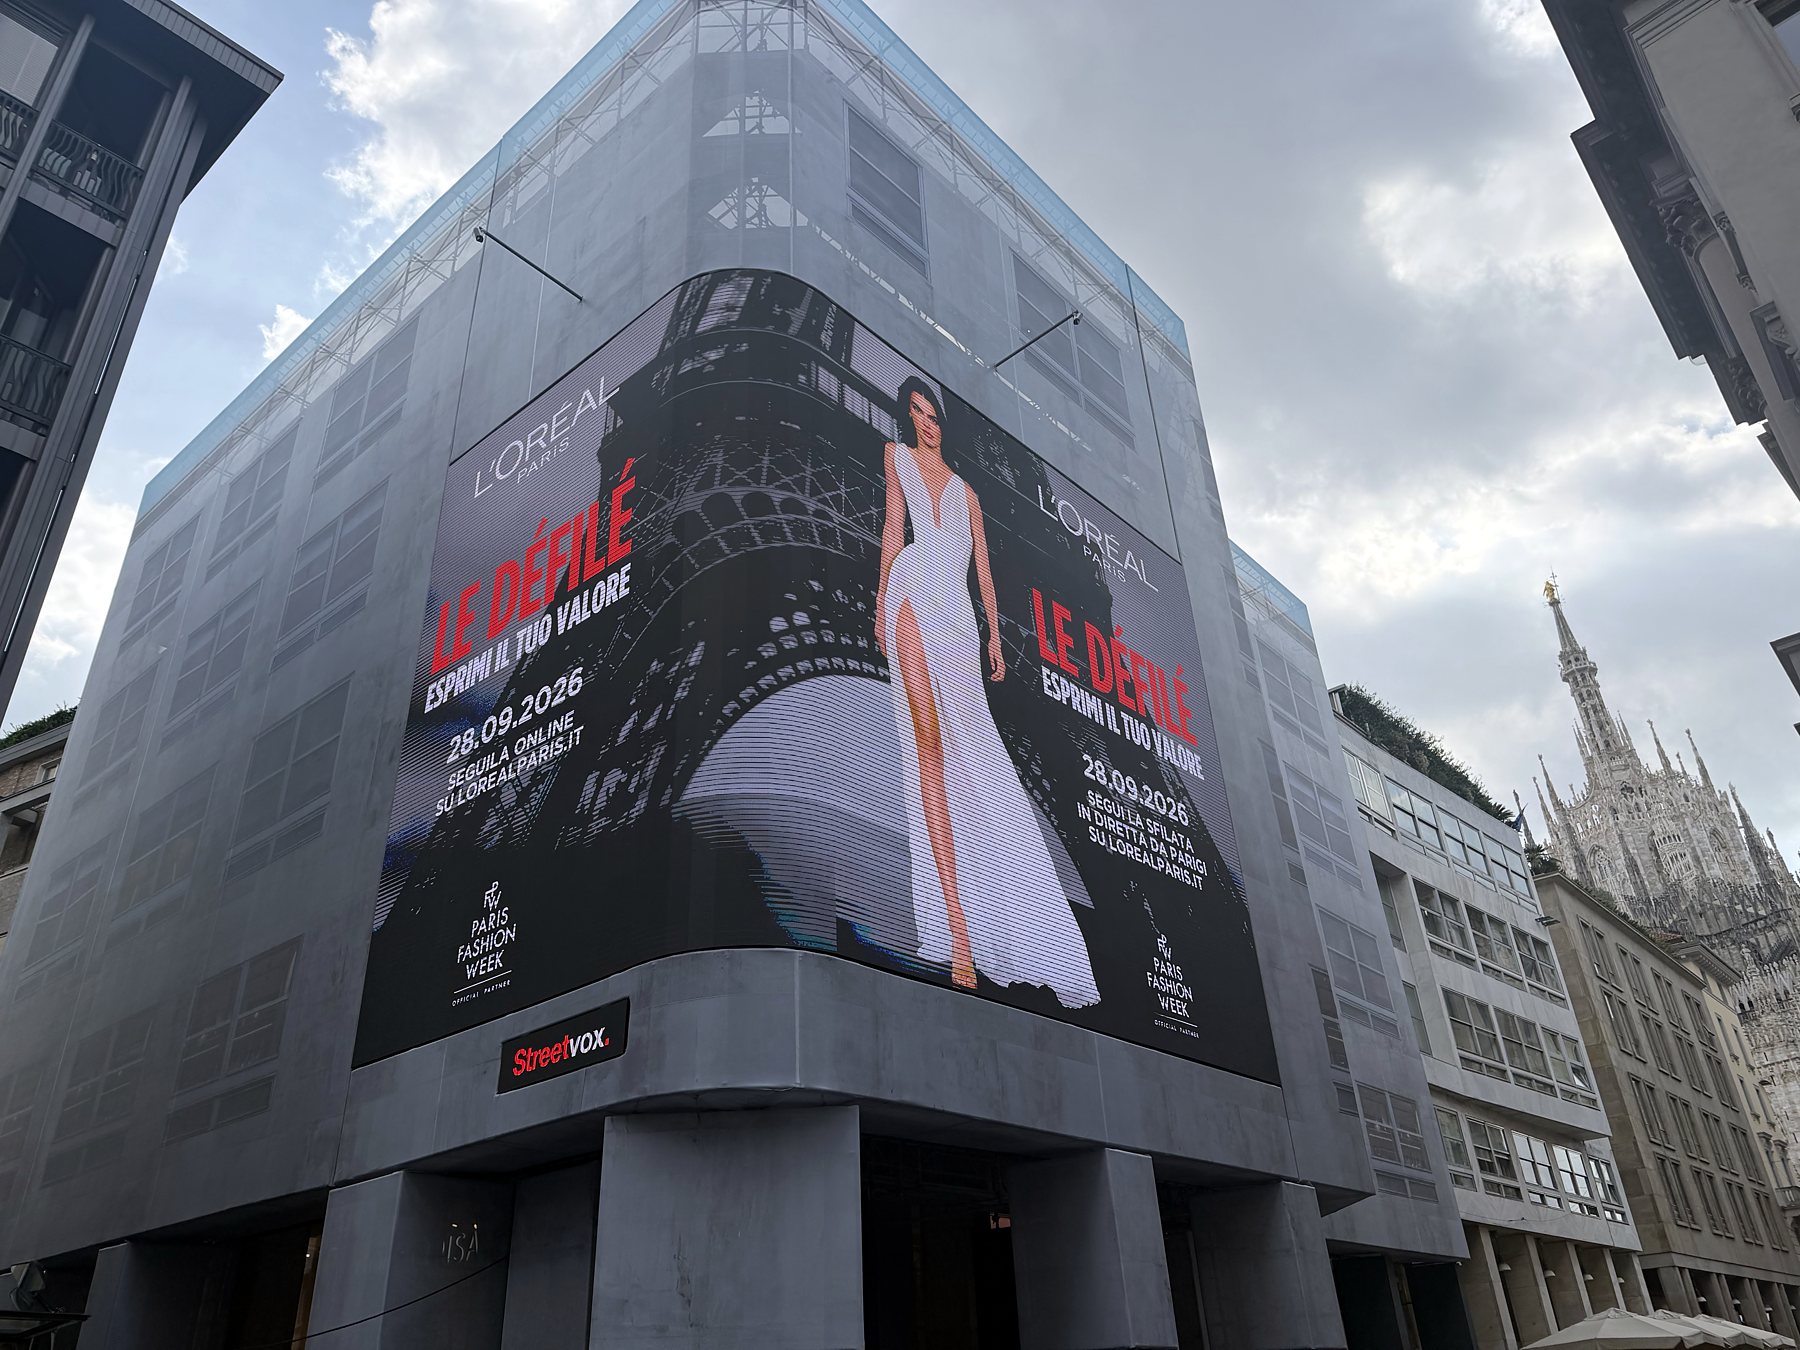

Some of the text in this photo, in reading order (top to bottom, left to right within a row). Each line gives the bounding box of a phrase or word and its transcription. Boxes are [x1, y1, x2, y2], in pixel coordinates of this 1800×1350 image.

[516, 437, 570, 483] PARIS
[430, 457, 636, 676] LE DÉFILÉ
[1083, 545, 1126, 583] PARIS
[424, 563, 632, 714] ESPRIMI IL TUO VALORE
[1032, 587, 1199, 747] LE DÉFILÉ
[446, 666, 584, 764] 28.09.2026
[514, 710, 576, 757] ONLINE
[1041, 665, 1205, 780] ESPRIMI IL TUO VALORE
[435, 725, 584, 816] SU LOREALPARIS.IT
[1082, 754, 1189, 826] 28.09.2026
[1077, 802, 1208, 877] IN DIRETTA DA PARIGI
[1086, 789, 1194, 853] SEGUI LA SFILATA
[1088, 825, 1203, 890] SU LOREALPARIS.IT
[457, 923, 517, 964] FASHION
[471, 907, 509, 938] PARIS
[465, 950, 504, 980] WEEK
[1146, 971, 1194, 1003] FASHION
[1153, 957, 1183, 981] PARIS
[451, 980, 511, 1007] OFFICIAL PARTNER
[1157, 993, 1190, 1018] WEEK
